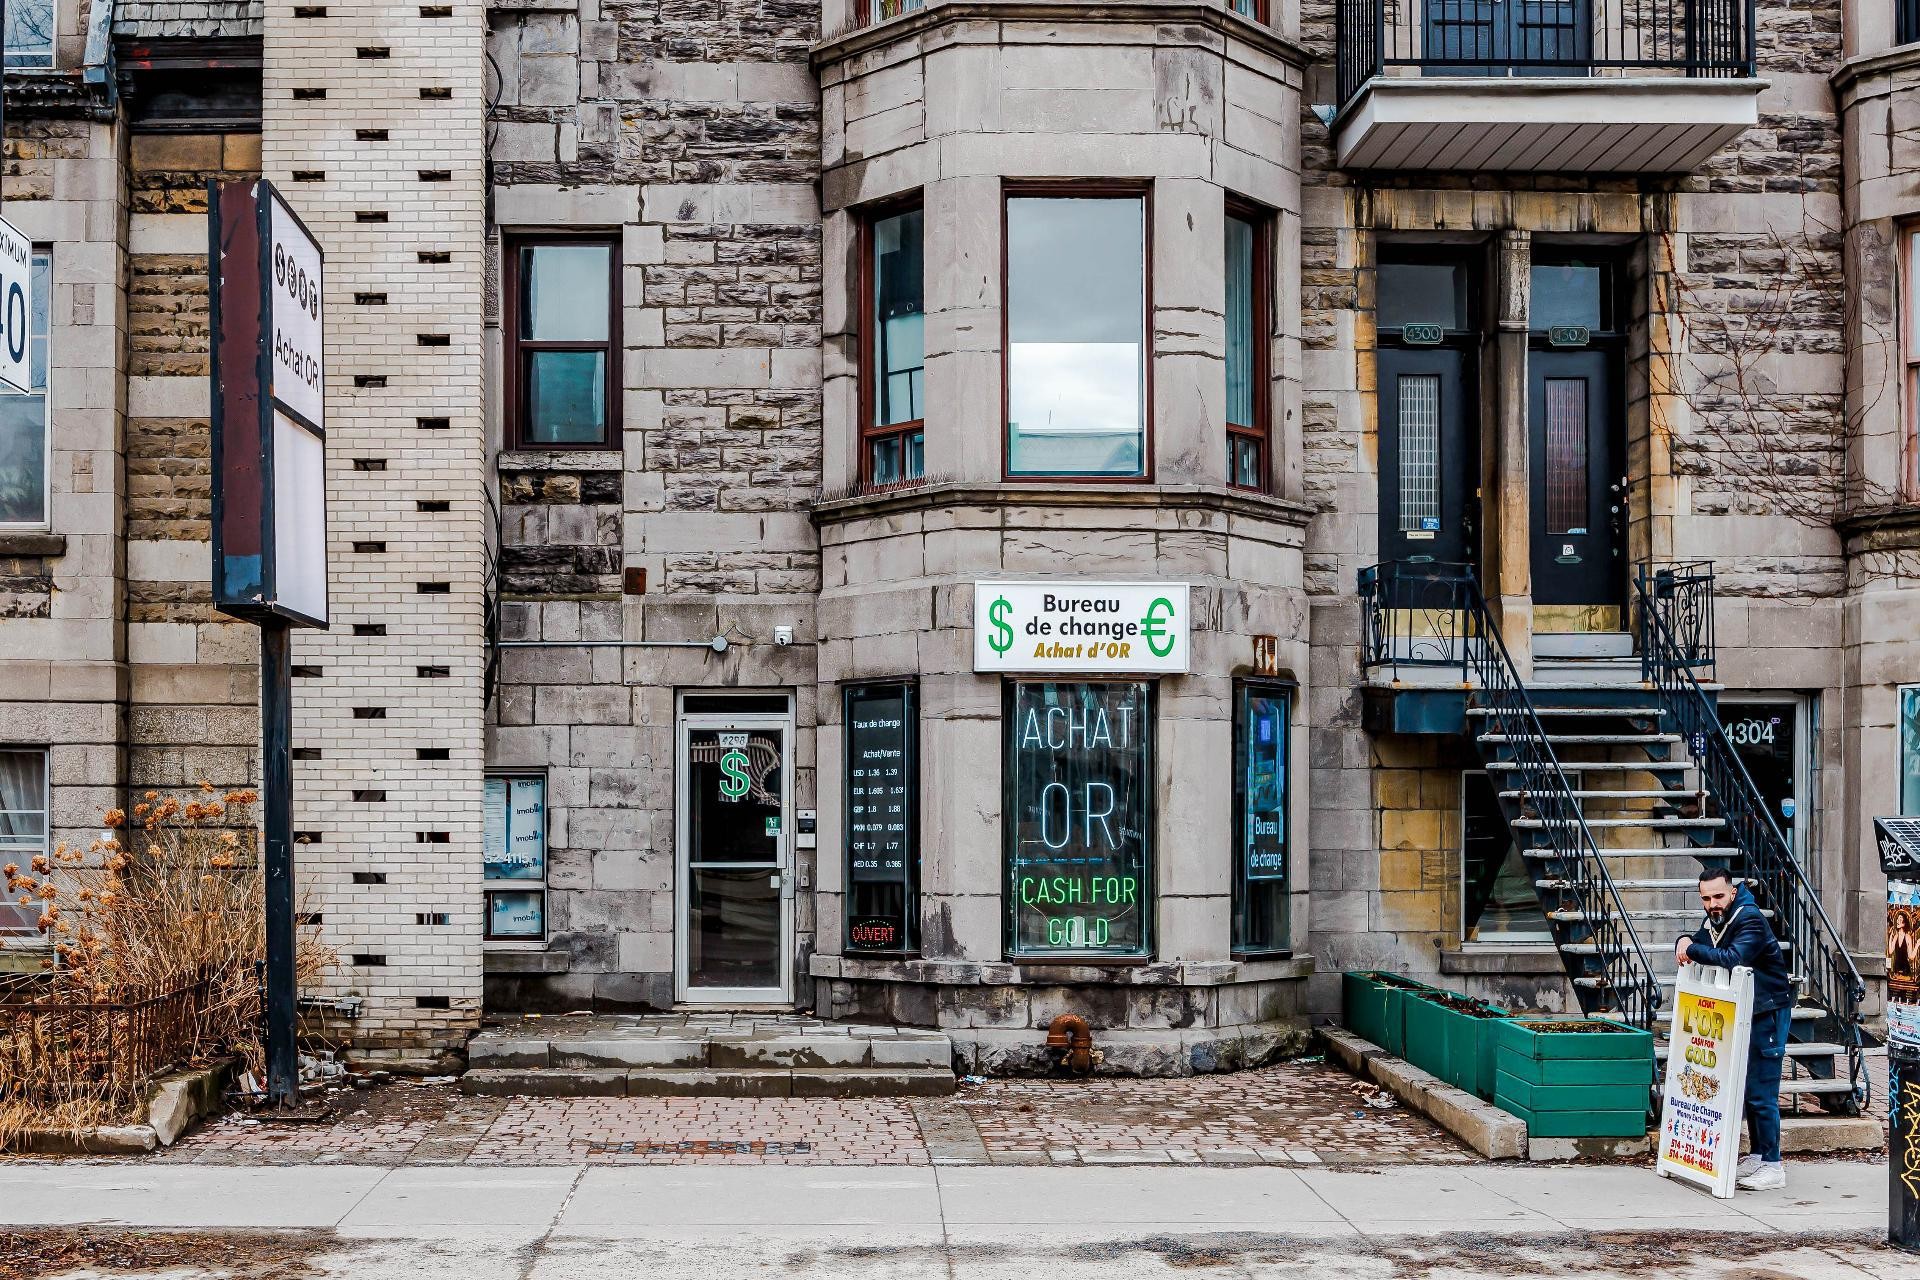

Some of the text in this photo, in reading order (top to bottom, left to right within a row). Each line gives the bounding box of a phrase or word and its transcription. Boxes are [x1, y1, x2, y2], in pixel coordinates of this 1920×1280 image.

[1407, 327, 1439, 340] 4300
[1554, 330, 1586, 342] 4302
[275, 328, 319, 393] Achat OR
[1043, 594, 1120, 613] Bureau
[1025, 616, 1138, 640] de change
[1034, 642, 1083, 658] Achat
[853, 719, 901, 729] Taux de change
[1023, 708, 1133, 749] ACHAT
[1724, 722, 1774, 744] 4304
[863, 749, 901, 759] Achat/Vente
[853, 769, 865, 777] USD
[853, 787, 865, 795] EUR
[1042, 783, 1115, 849] OR
[1255, 816, 1278, 835] Bureau
[853, 842, 899, 850] CHF 1.7 1.77
[853, 860, 865, 868] AED
[865, 860, 878, 868] 0.35
[1250, 850, 1282, 871] de change
[1022, 878, 1135, 904] CASH FOR
[852, 926, 895, 941] OUVERT
[1049, 918, 1108, 944] GOLD
[1698, 999, 1715, 1009] ACHAT
[1704, 1039, 1715, 1049] FOR
[1685, 1045, 1717, 1068] GOLD
[1670, 1096, 1723, 1121] Bureau de Change
[1676, 1109, 1714, 1128] Money Exchange
